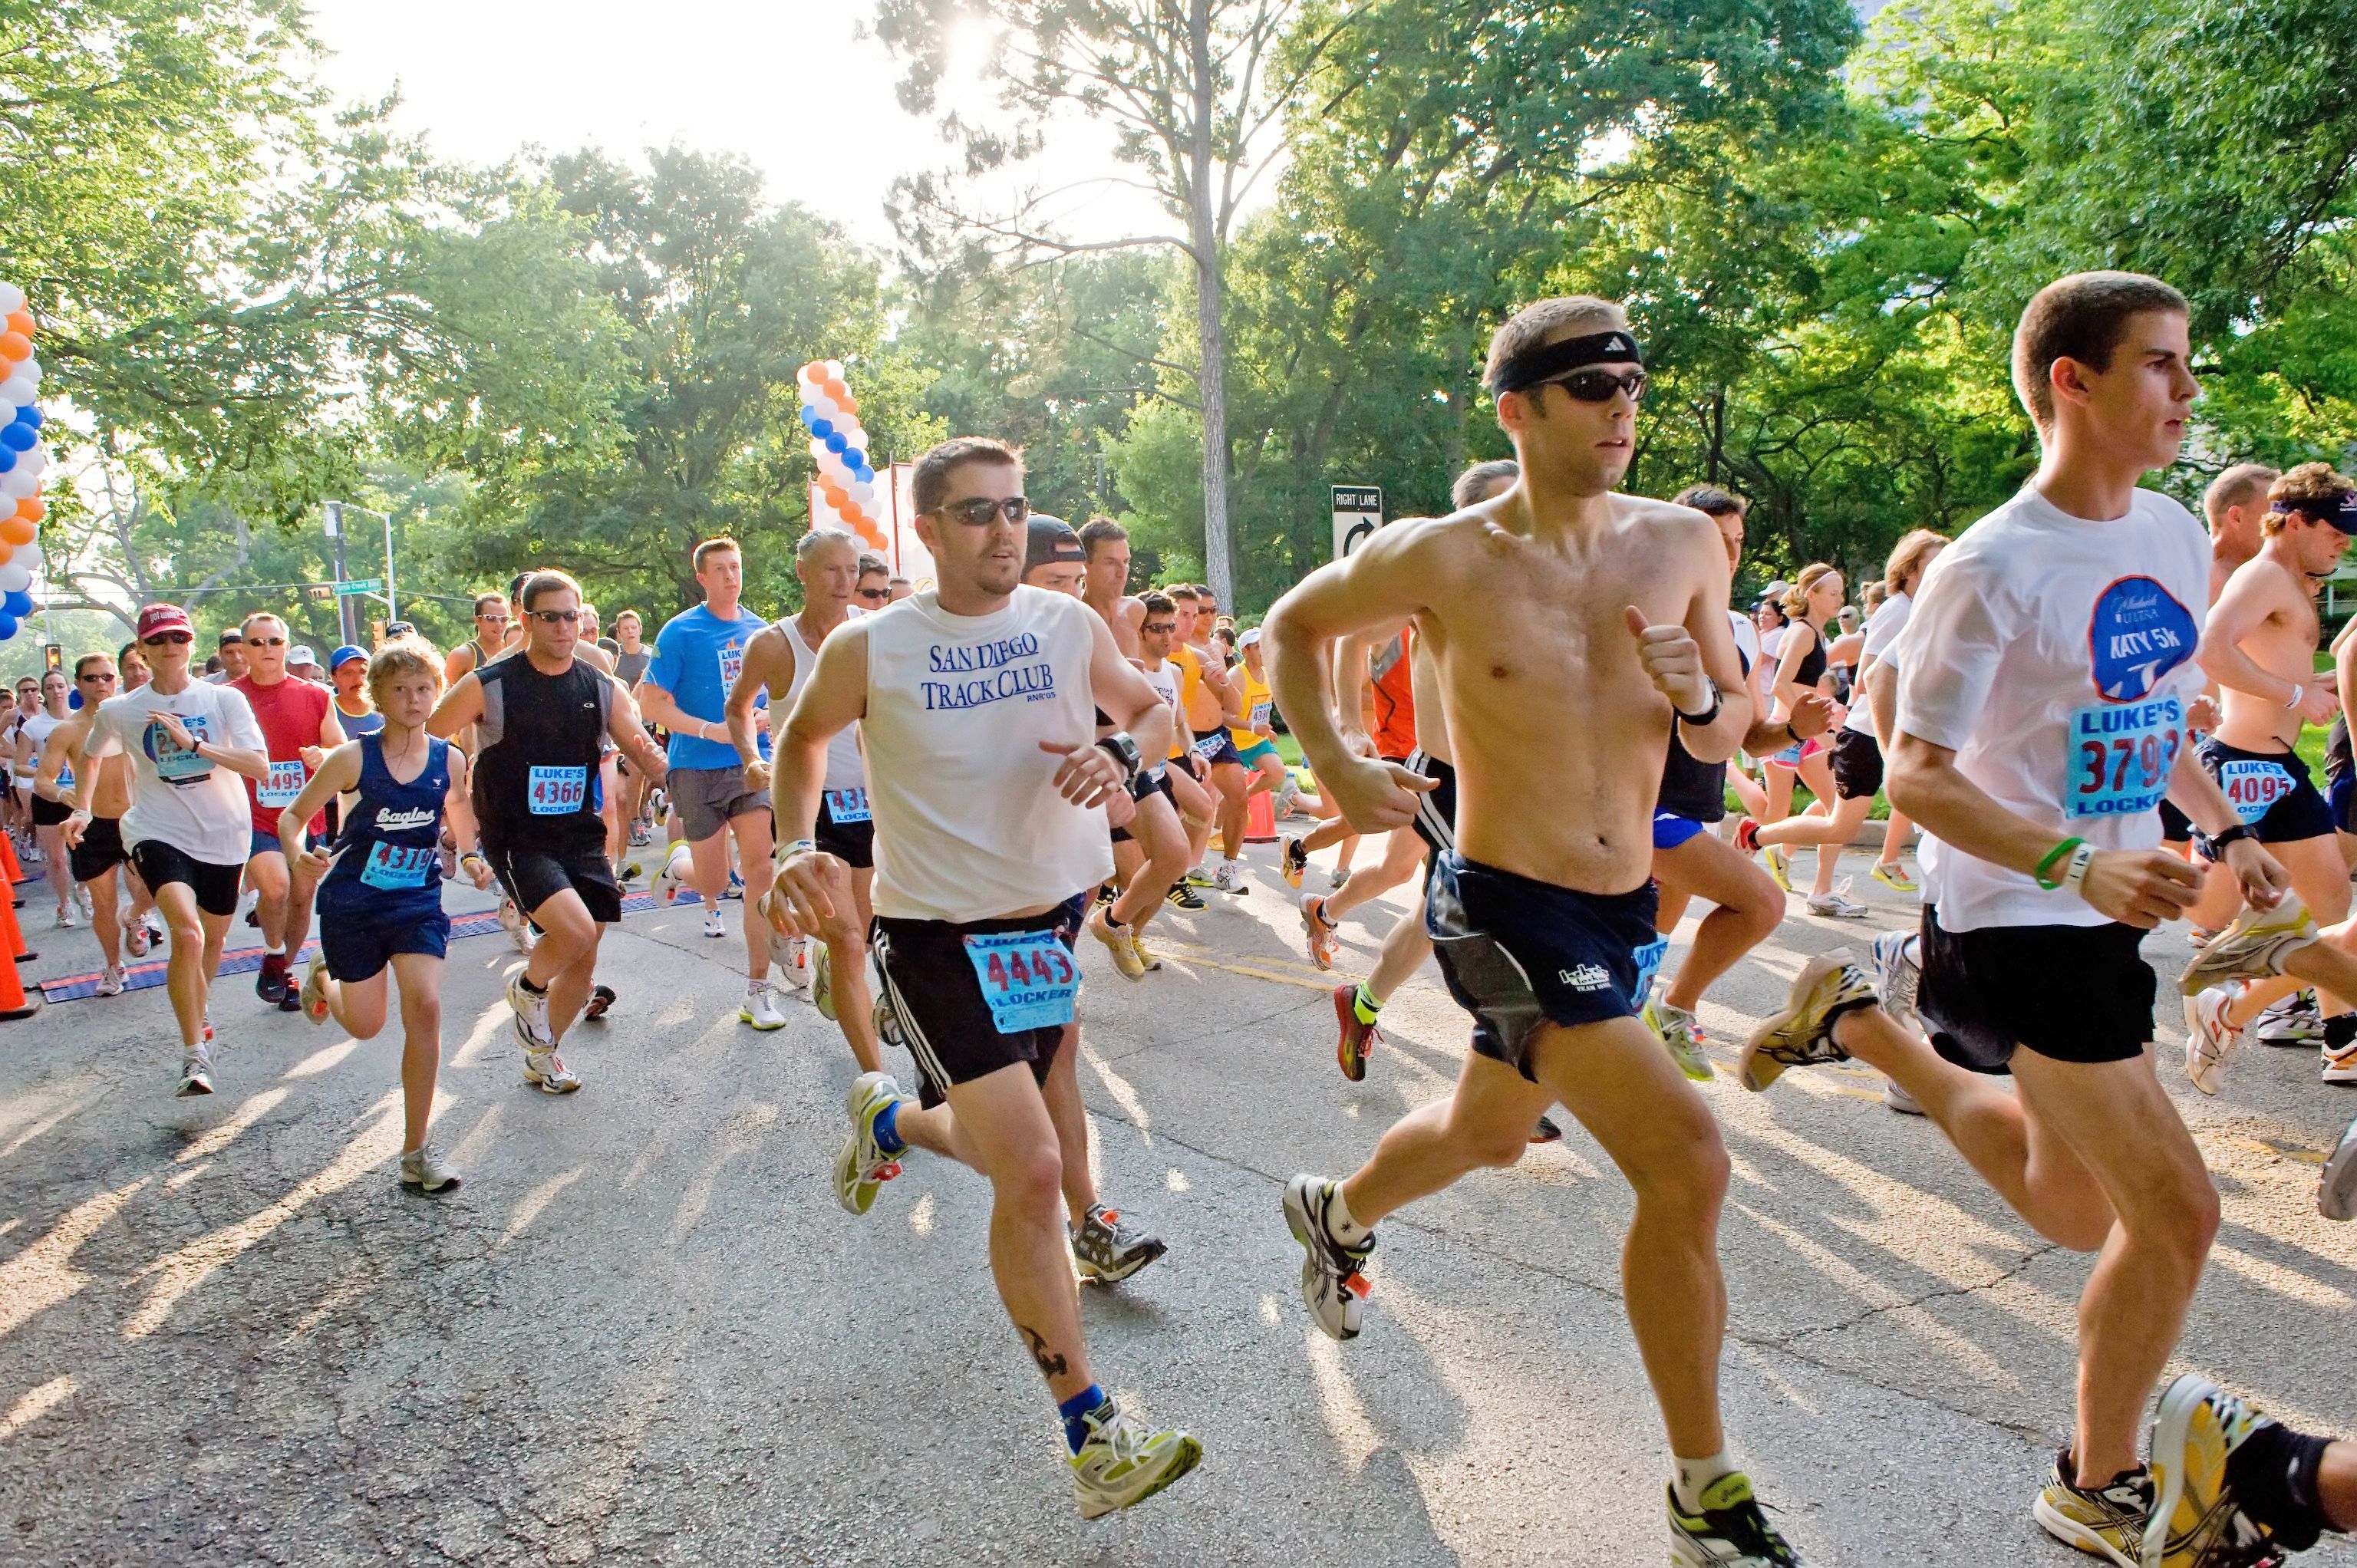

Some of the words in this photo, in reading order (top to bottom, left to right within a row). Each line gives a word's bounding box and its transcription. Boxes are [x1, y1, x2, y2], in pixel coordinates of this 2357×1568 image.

[1336, 493, 1356, 506] RIGHT
[1359, 494, 1378, 506] LANE
[150, 611, 160, 624] got
[721, 650, 743, 659] LUK
[929, 644, 973, 673] SAN
[975, 632, 1040, 669] DIEGO
[2110, 631, 2153, 659] KATY
[921, 678, 996, 710] TRACK
[997, 664, 1053, 698] CLUB
[1027, 691, 1057, 703] RNR'05
[2081, 700, 2180, 734] LUKE'S
[535, 769, 585, 779] LUKE'S
[534, 781, 583, 804] 4366
[2228, 776, 2291, 804] 4095
[374, 806, 436, 830] Eagles
[837, 812, 872, 821] LOCK
[987, 949, 1073, 993] 4443
[995, 989, 1073, 1007] LOCKER
